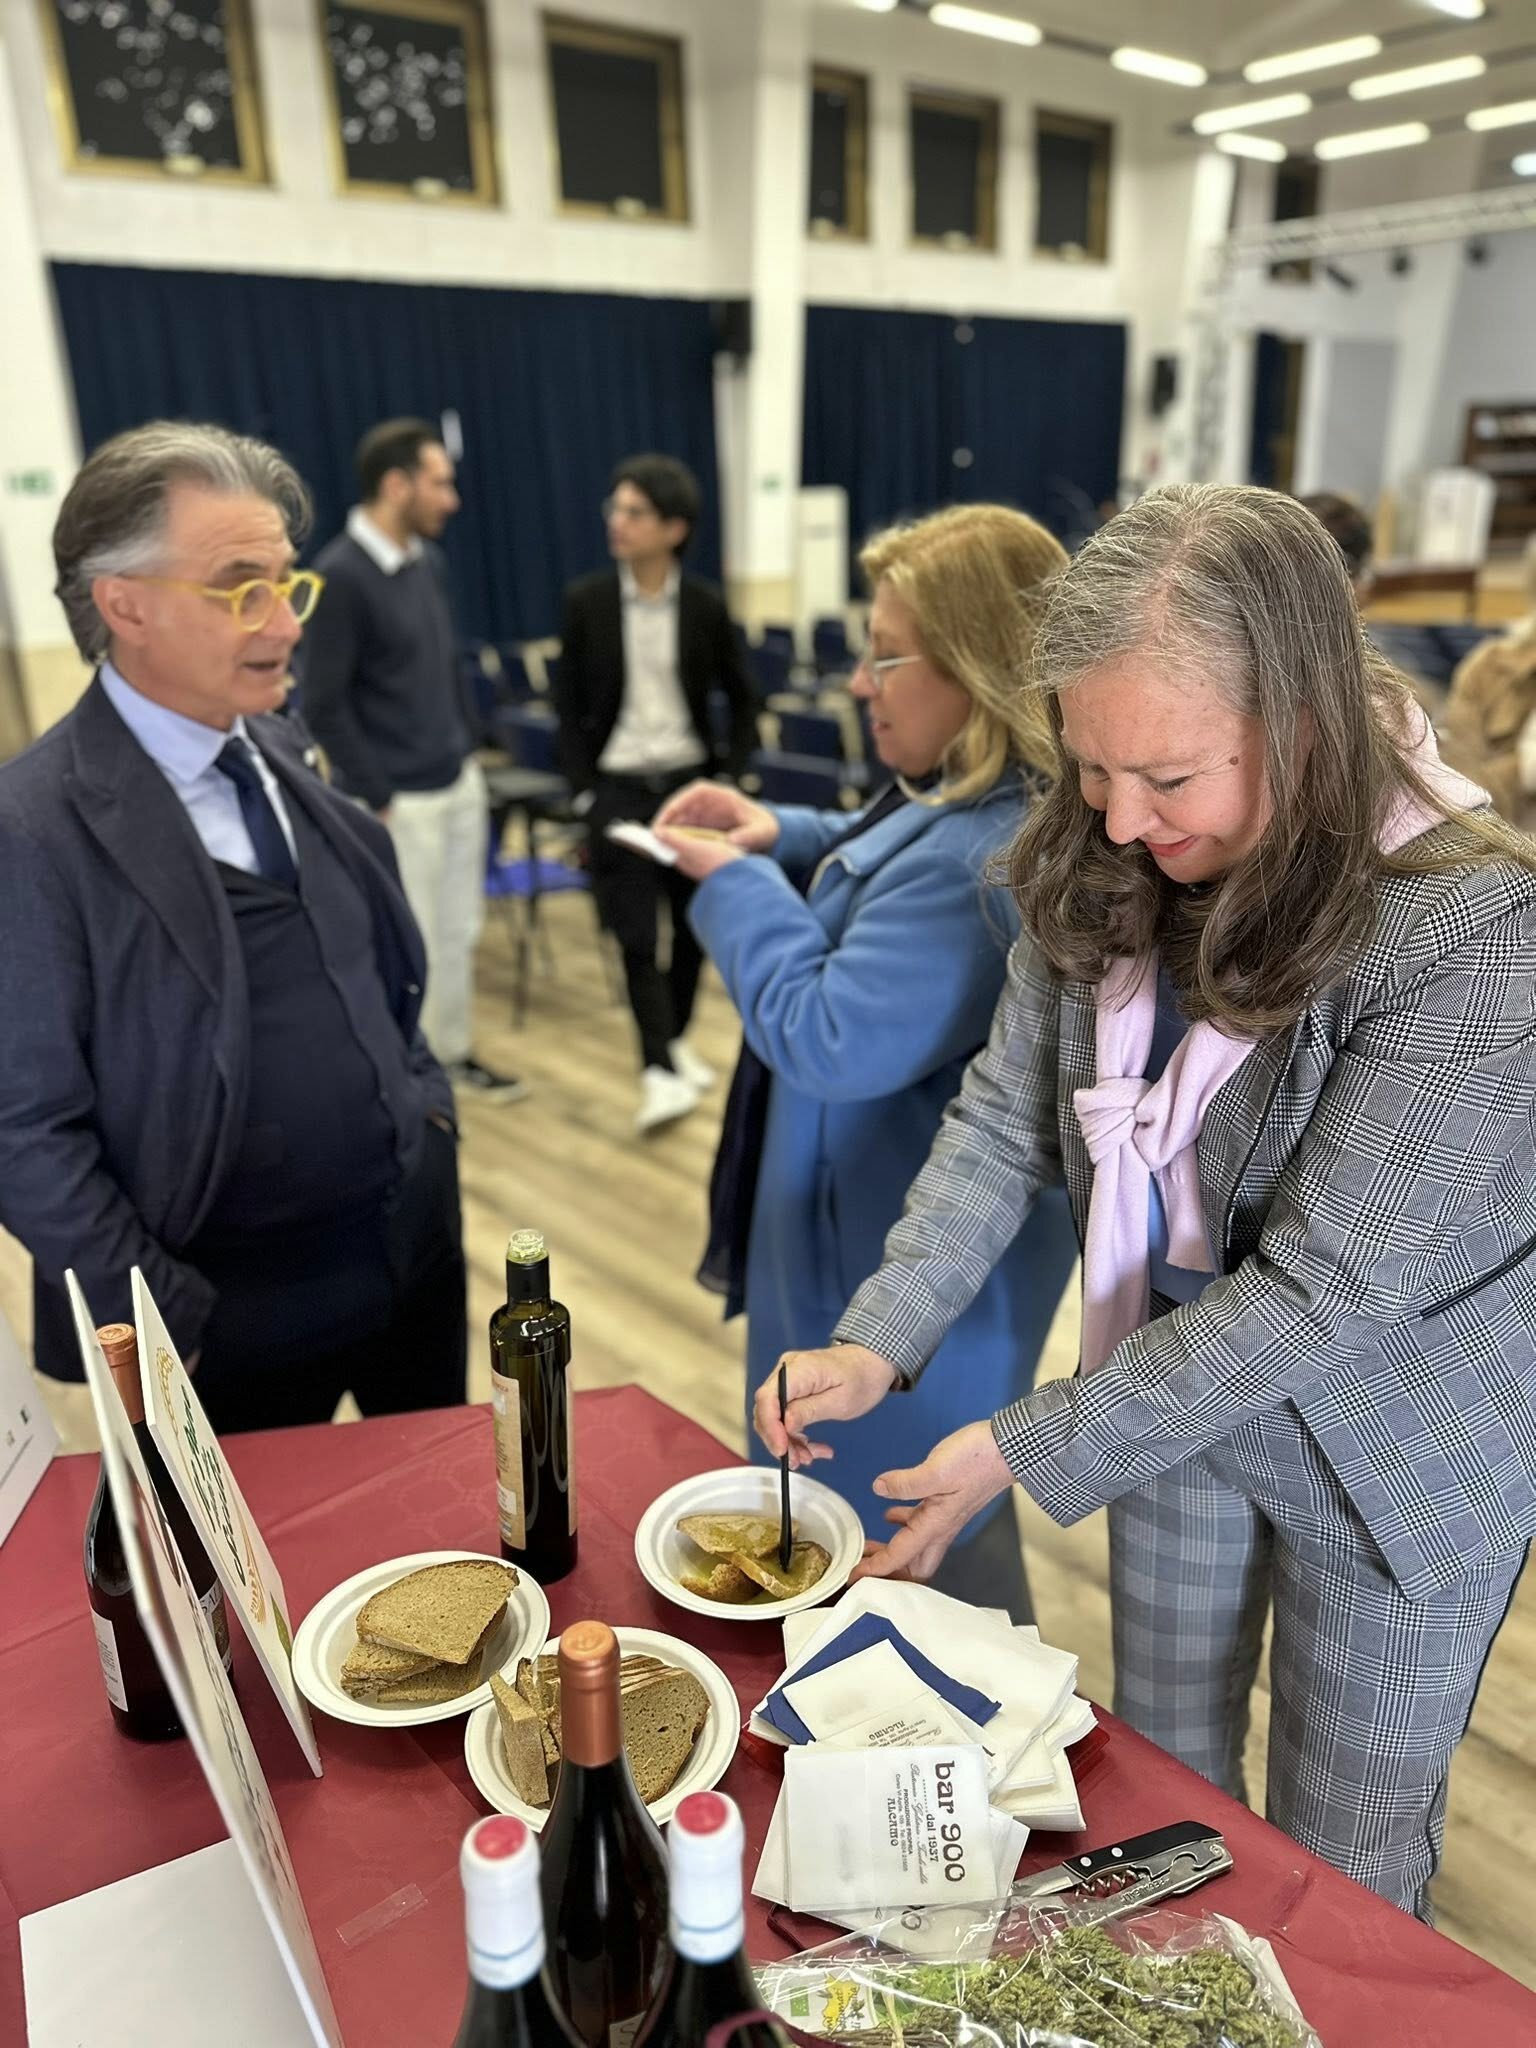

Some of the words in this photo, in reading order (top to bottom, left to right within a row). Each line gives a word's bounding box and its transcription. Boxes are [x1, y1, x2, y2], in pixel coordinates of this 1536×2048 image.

[868, 1720, 906, 1741] ALCAMO
[903, 1788, 911, 1826] PRODUZIONE
[934, 1760, 956, 1815] bar
[887, 1797, 899, 1846] ALCAMO
[928, 1836, 939, 1862] 1937
[940, 1823, 966, 1883] 900
